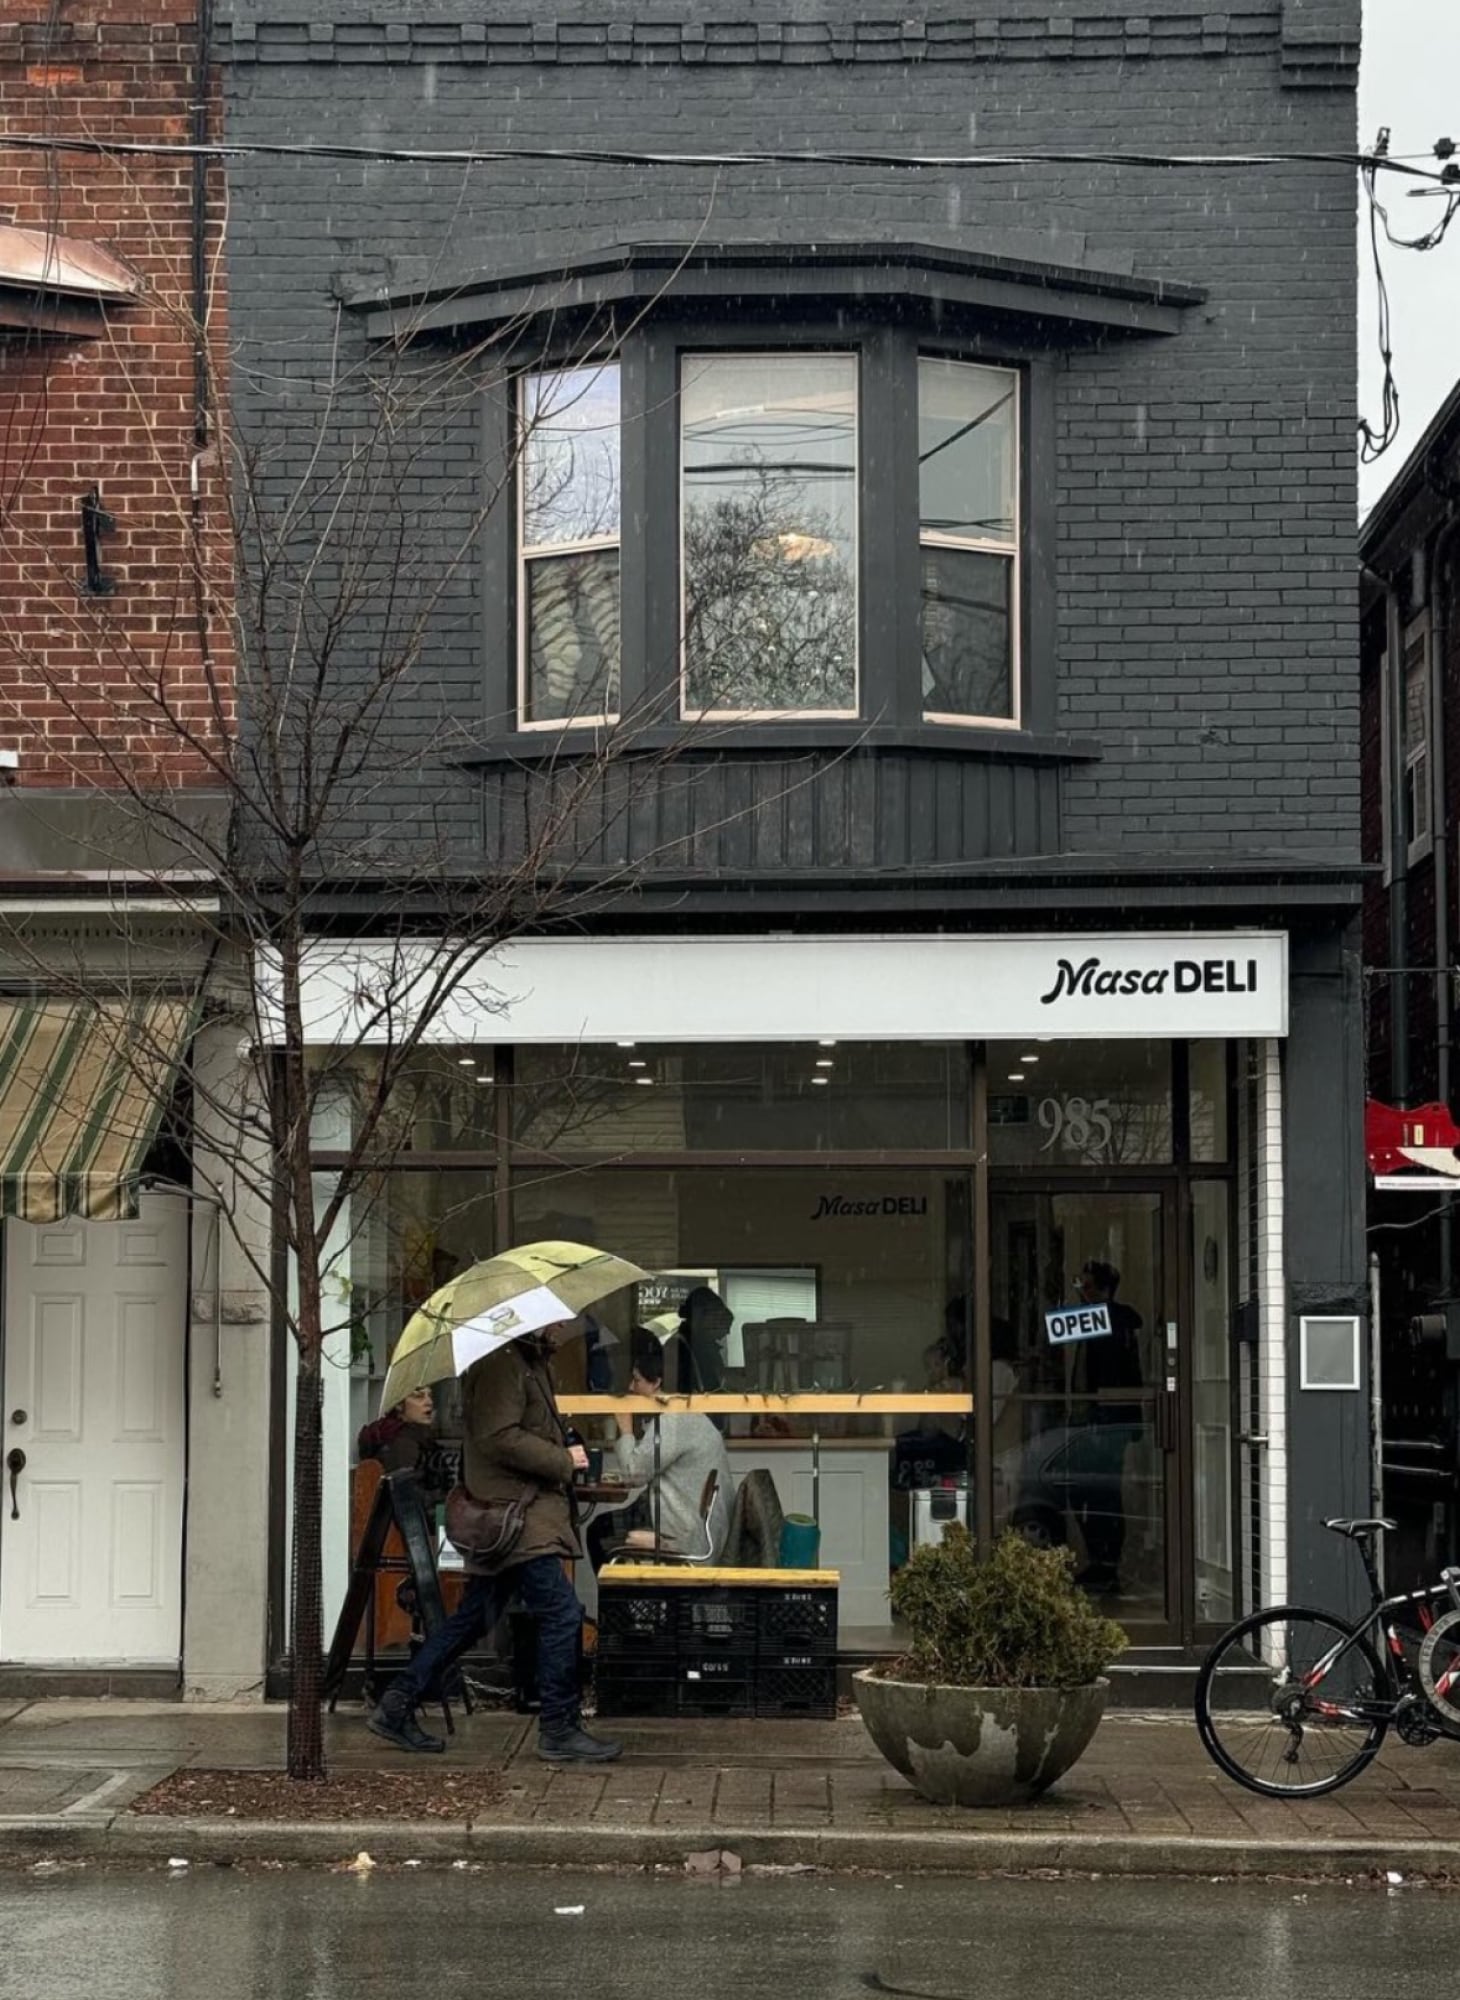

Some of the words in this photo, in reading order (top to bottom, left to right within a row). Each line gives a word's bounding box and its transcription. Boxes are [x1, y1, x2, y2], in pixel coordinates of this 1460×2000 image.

[1040, 957, 1170, 1005] Masa
[1174, 959, 1257, 993] DELI
[1038, 1096, 1112, 1152] 985
[809, 1195, 880, 1220] Masa
[882, 1196, 927, 1215] DELI
[1050, 1309, 1107, 1338] OPEN
